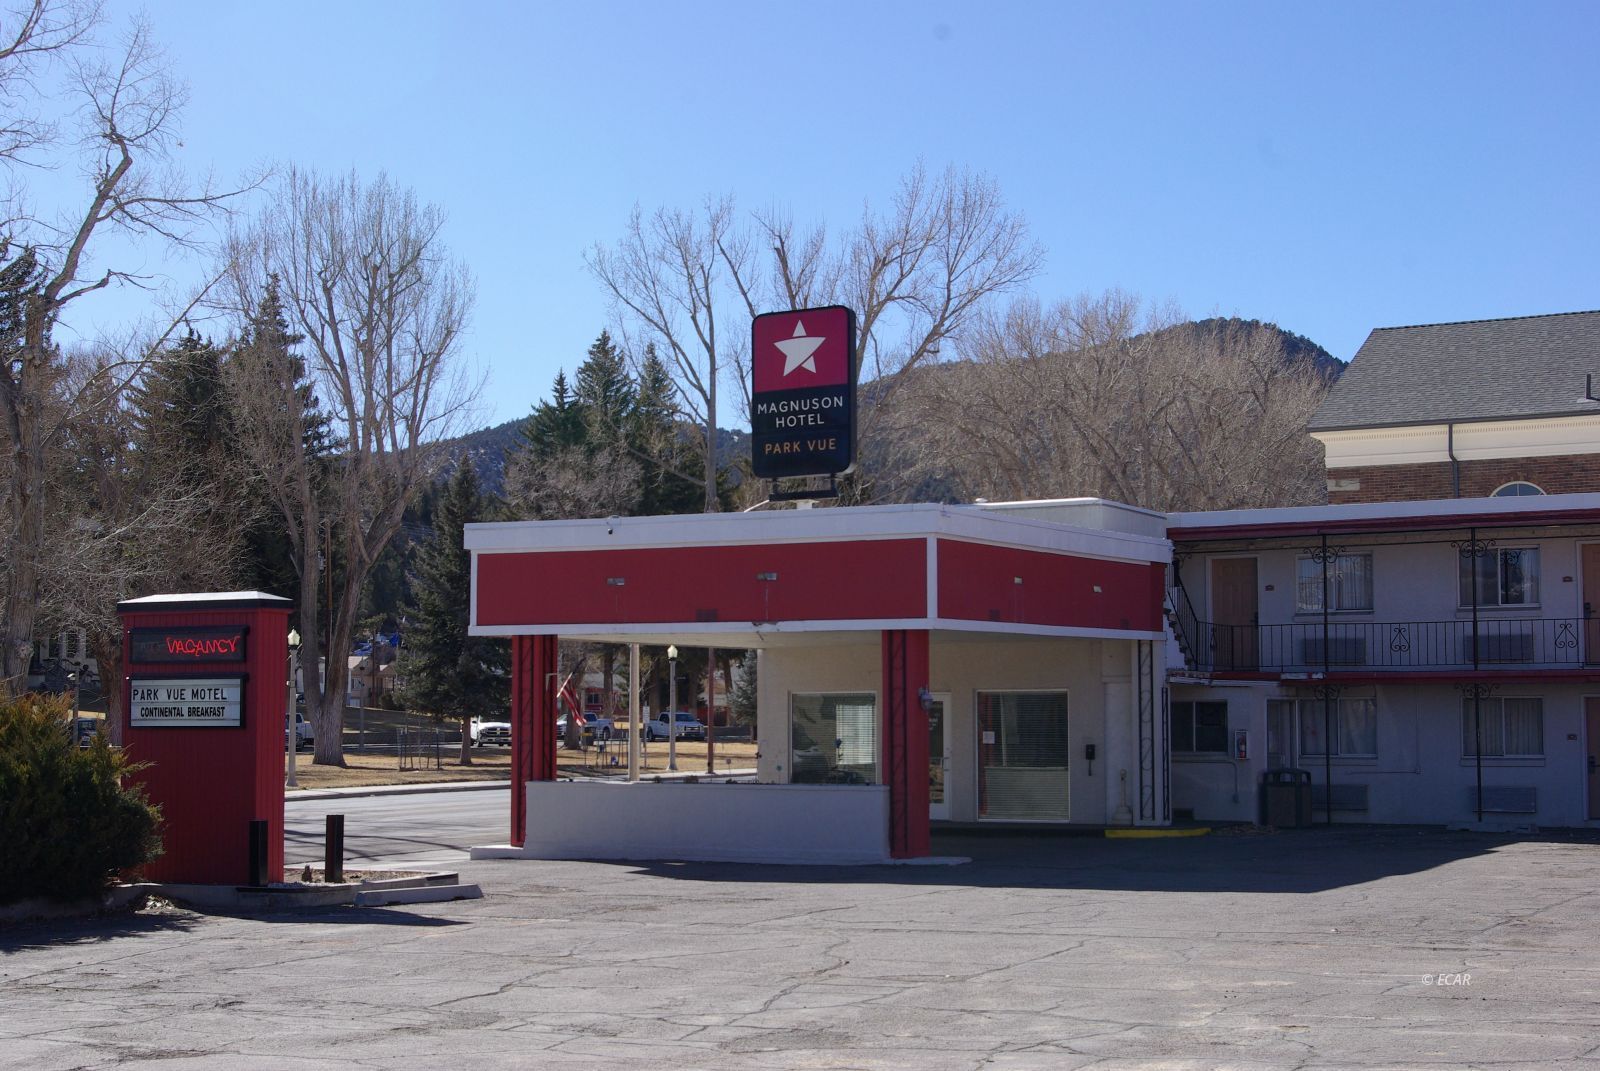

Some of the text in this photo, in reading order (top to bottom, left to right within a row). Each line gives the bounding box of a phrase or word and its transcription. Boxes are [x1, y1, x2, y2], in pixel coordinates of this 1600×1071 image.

[757, 396, 844, 415] MAGNUSON
[775, 413, 825, 428] HOTEL
[765, 438, 836, 455] PARK VUE
[166, 636, 240, 656] VACANCY
[132, 688, 227, 700] PARK VUE MOTEL
[140, 706, 226, 717] CONTINENTAL BREAKFAST
